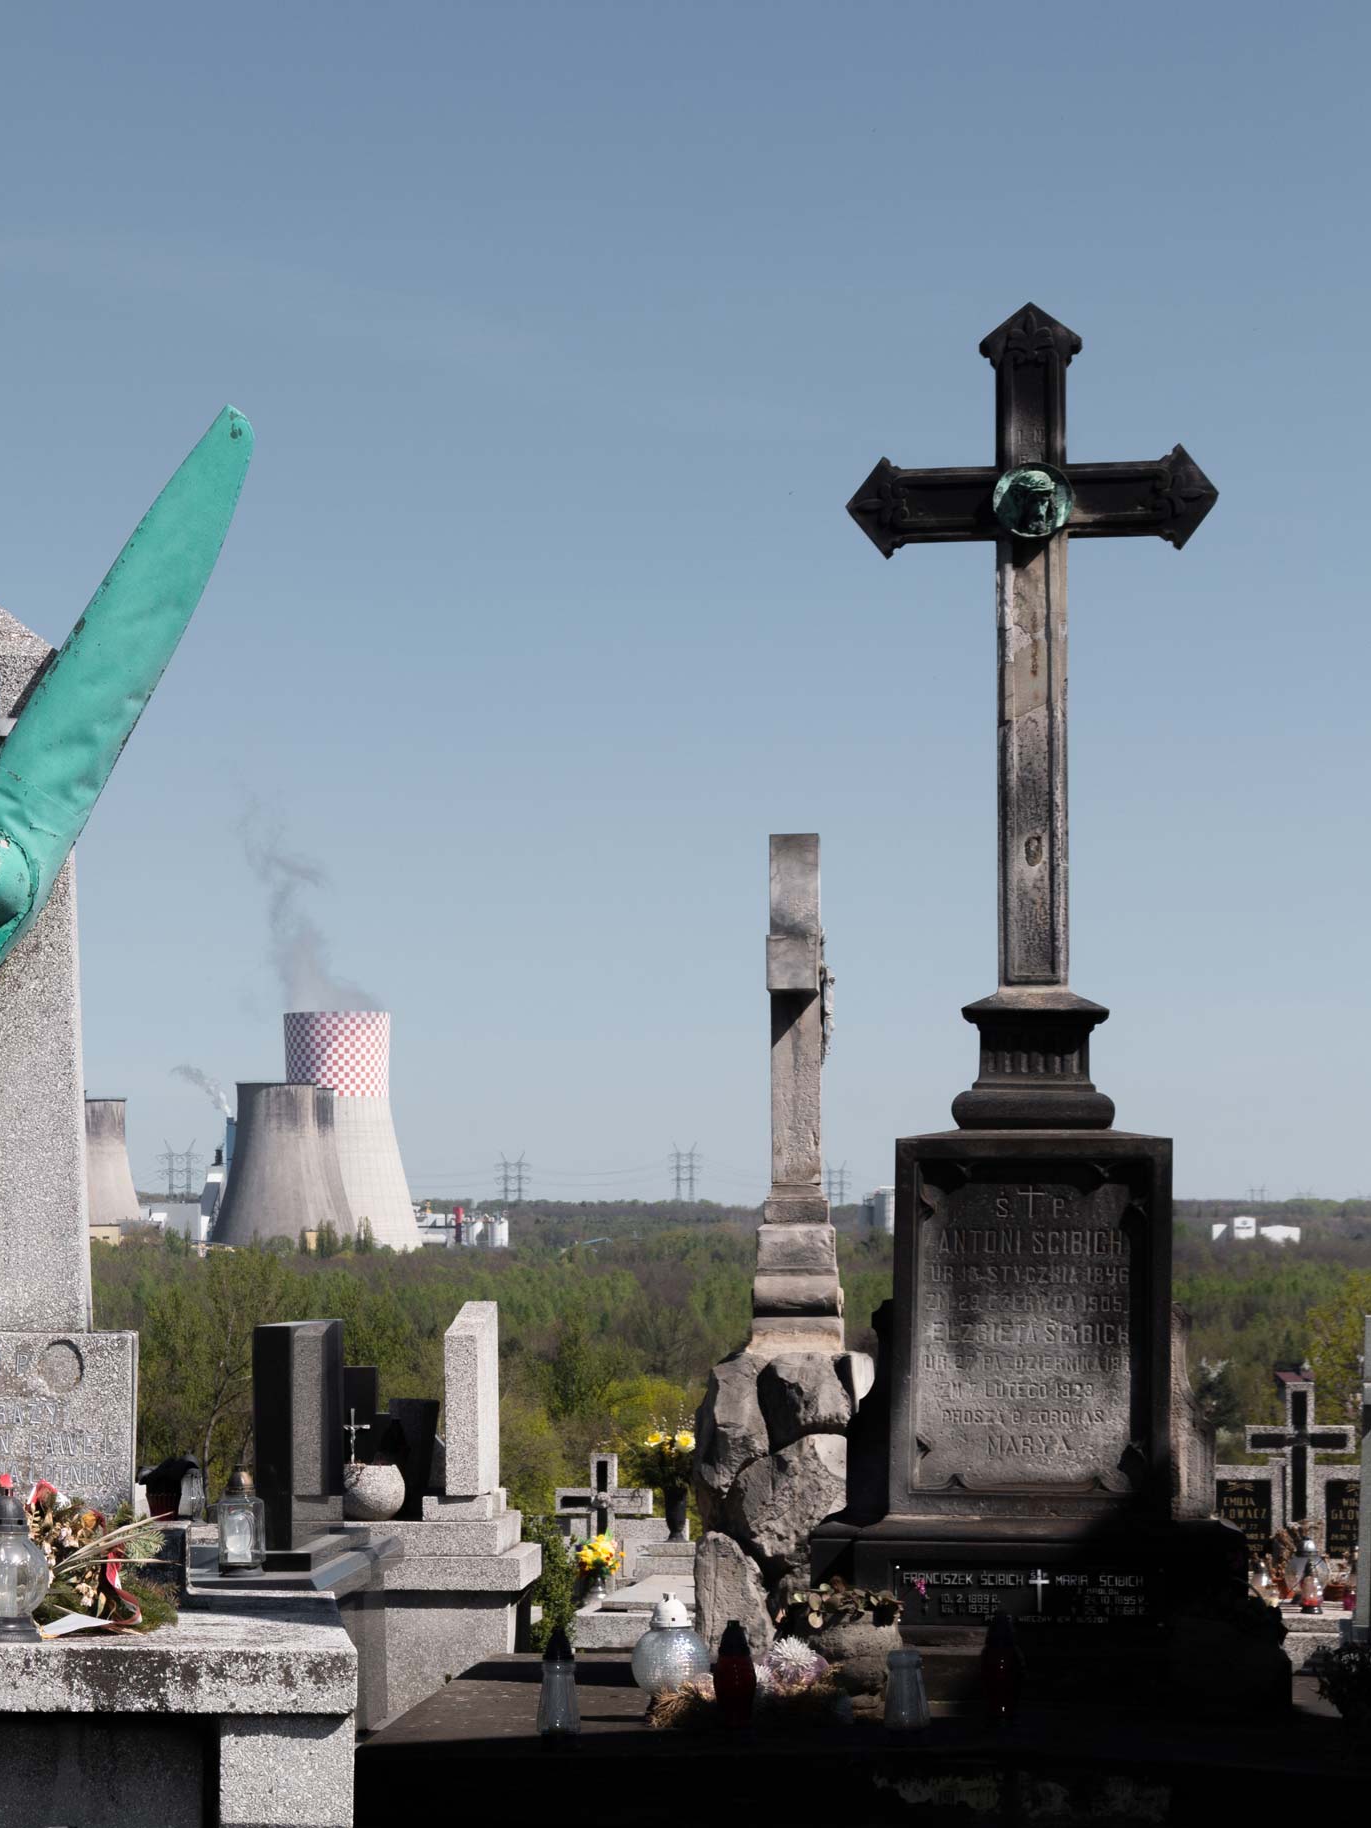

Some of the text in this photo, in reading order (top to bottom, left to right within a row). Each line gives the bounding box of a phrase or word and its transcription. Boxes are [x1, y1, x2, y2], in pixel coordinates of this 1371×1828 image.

[939, 1229, 1021, 1255] ANTONI
[30, 1462, 117, 1485] LOTNIKA
[902, 1569, 1024, 1586] FRANCISZEK ŚCIBICH
[1055, 1574, 1088, 1586] MARIA
